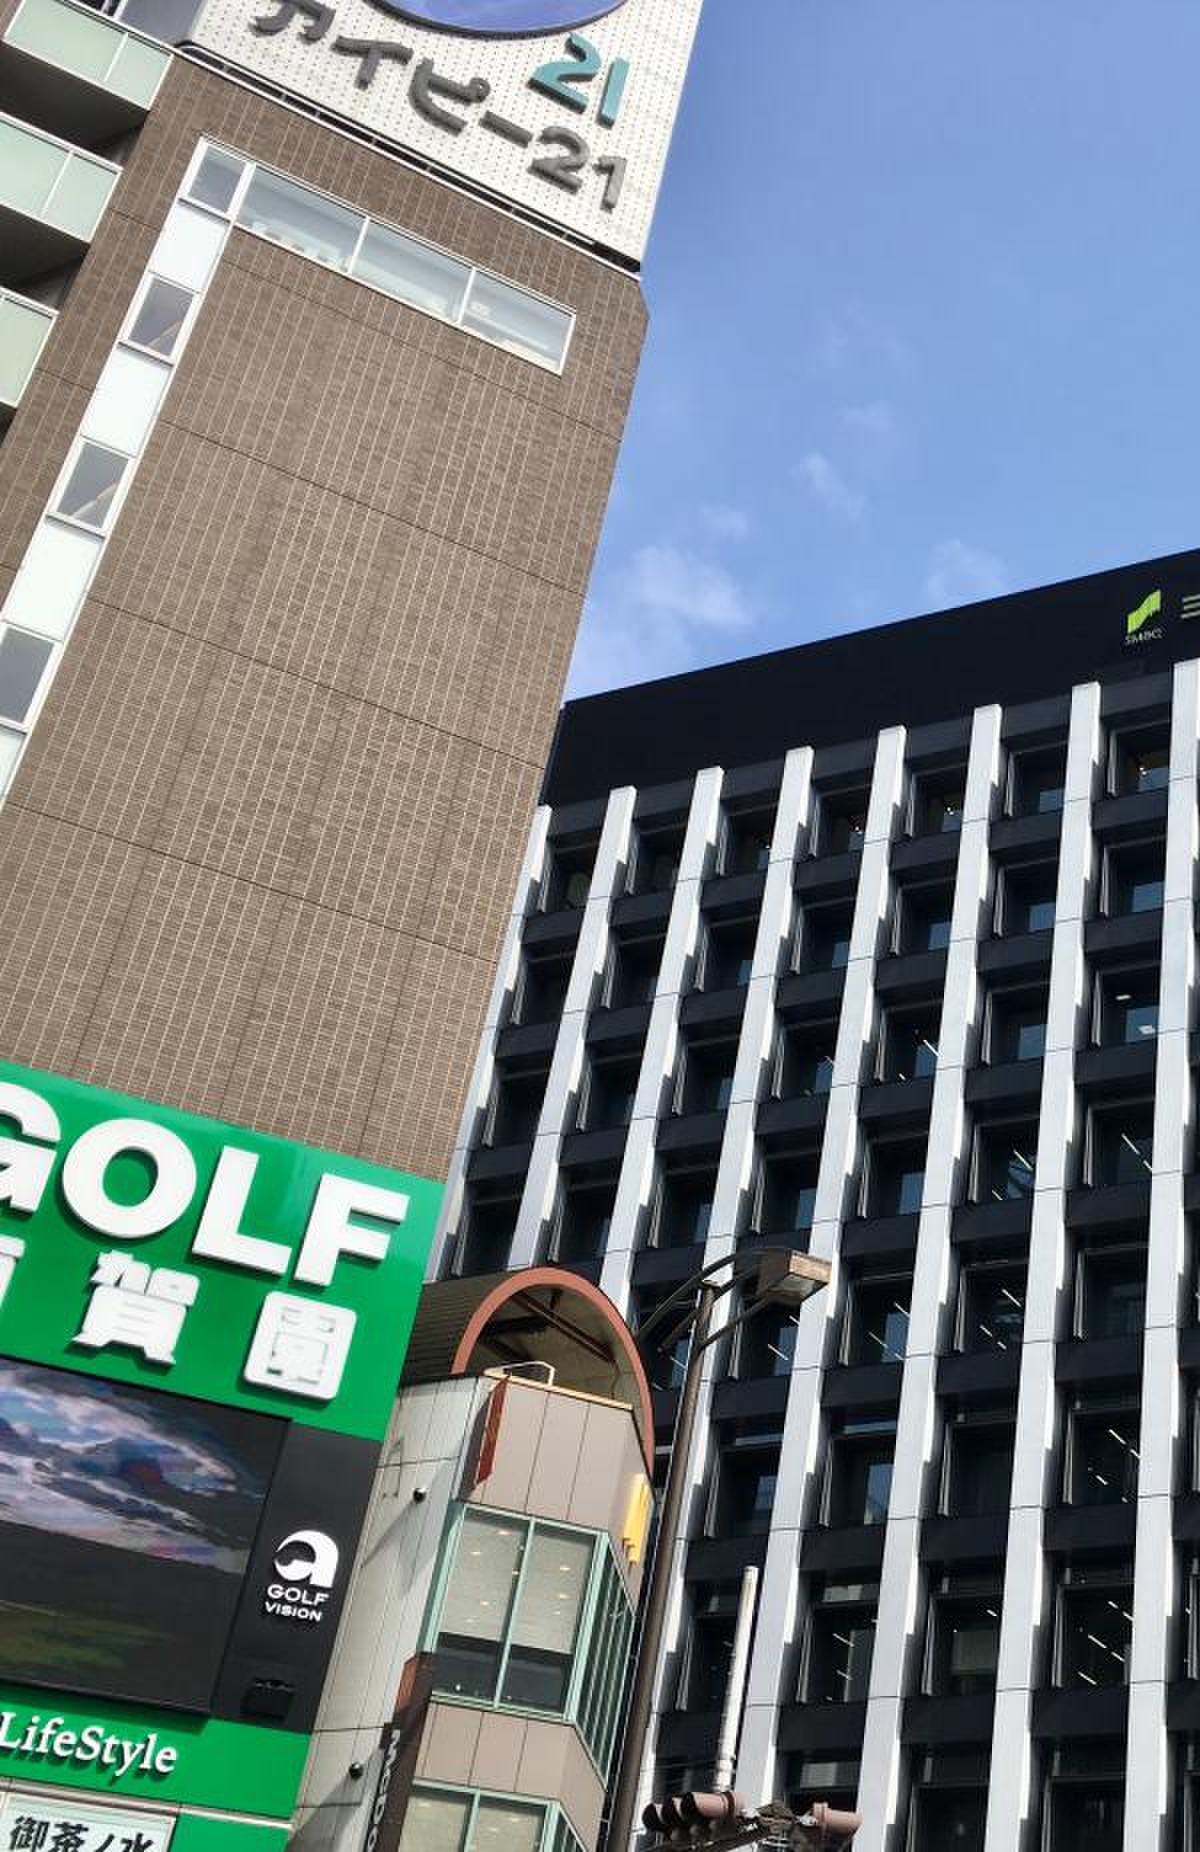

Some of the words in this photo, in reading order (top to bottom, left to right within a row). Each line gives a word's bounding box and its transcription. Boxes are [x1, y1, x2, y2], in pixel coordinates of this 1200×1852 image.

[527, 32, 630, 129] 21
[0, 1234, 357, 1400] 賀園
[265, 1601, 322, 1622] VISION
[267, 1584, 329, 1606] GOLF
[0, 1711, 177, 1776] LifeStyle
